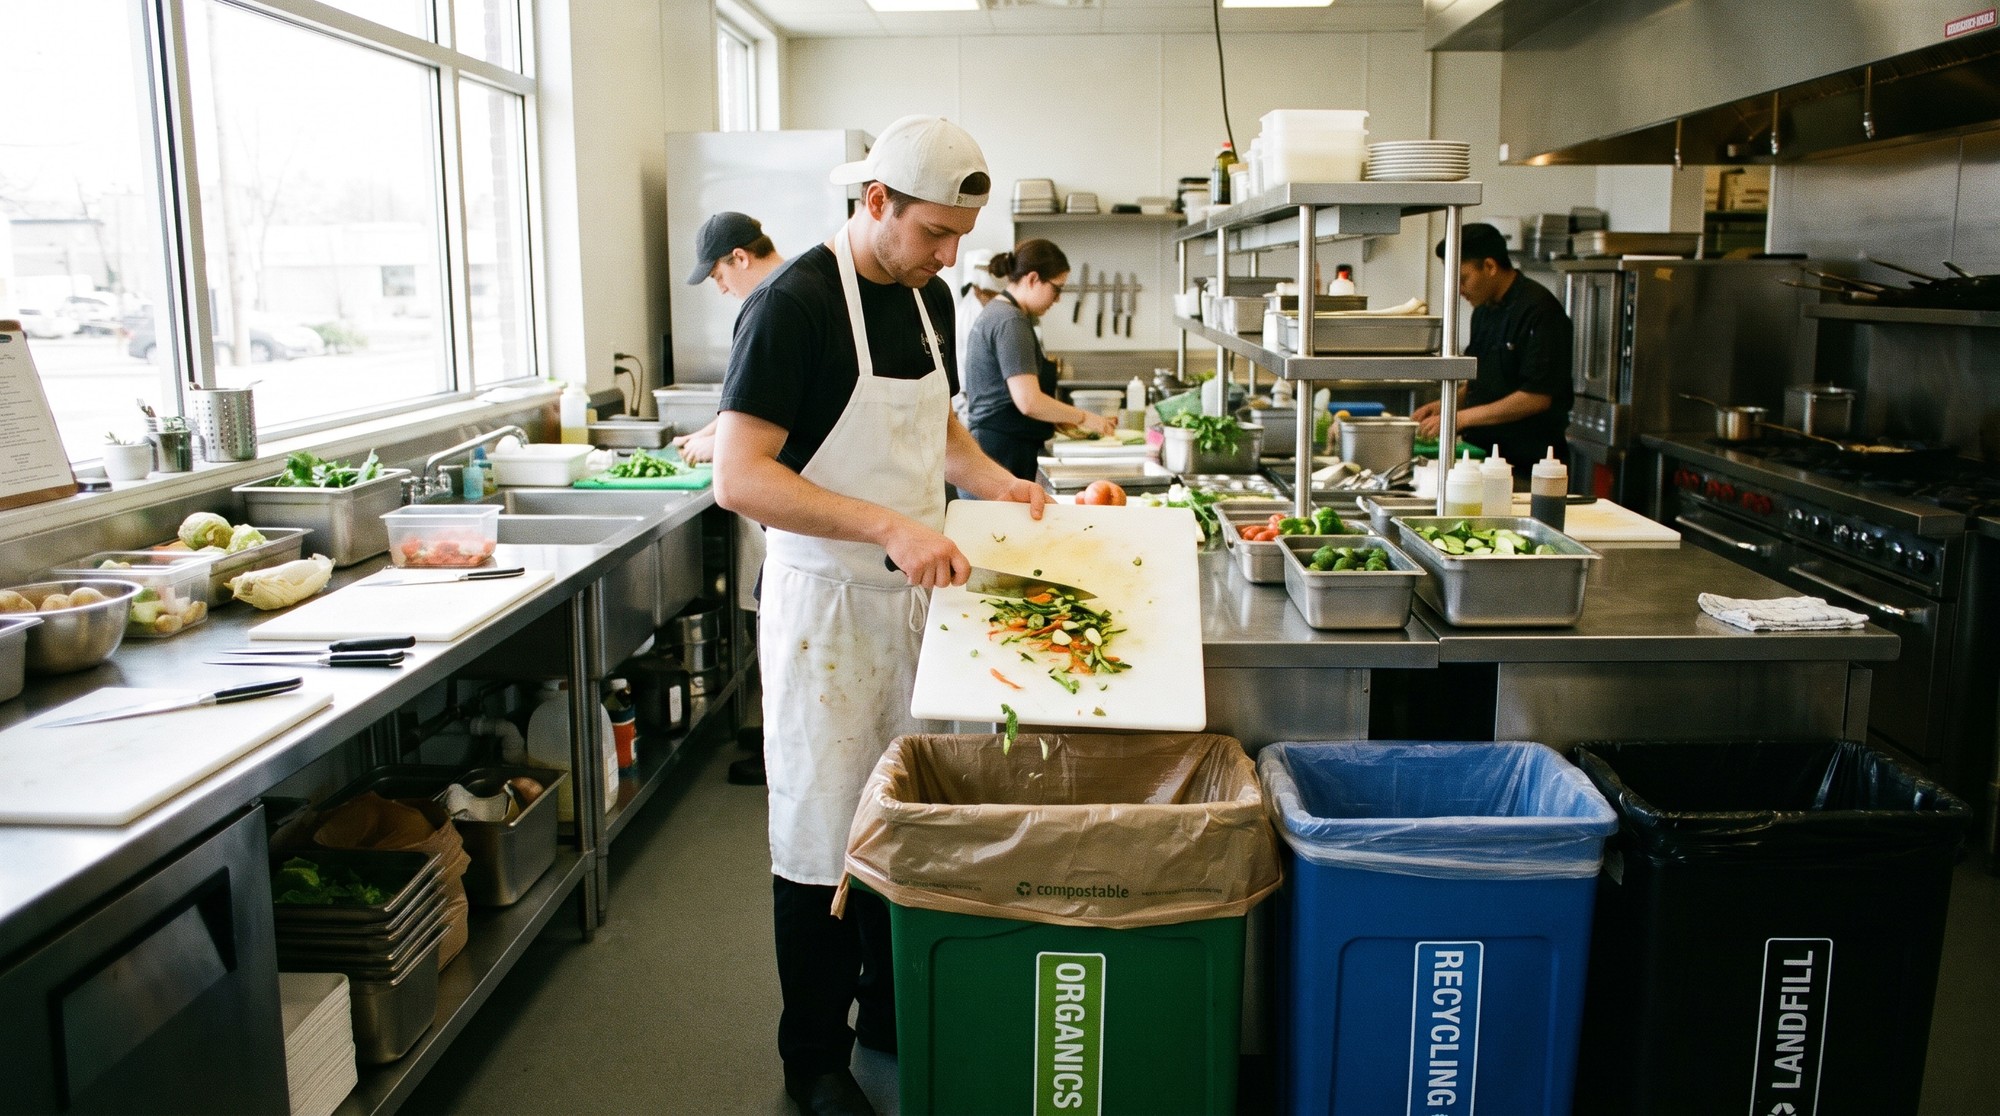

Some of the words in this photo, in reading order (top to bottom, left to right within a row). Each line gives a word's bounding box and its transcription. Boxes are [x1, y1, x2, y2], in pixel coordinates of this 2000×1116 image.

[1037, 884, 1129, 899] compostable
[1053, 962, 1086, 1108] ORGANICS
[1426, 950, 1464, 1106] RECYCLING
[1771, 950, 1813, 1088] LANDFILL
